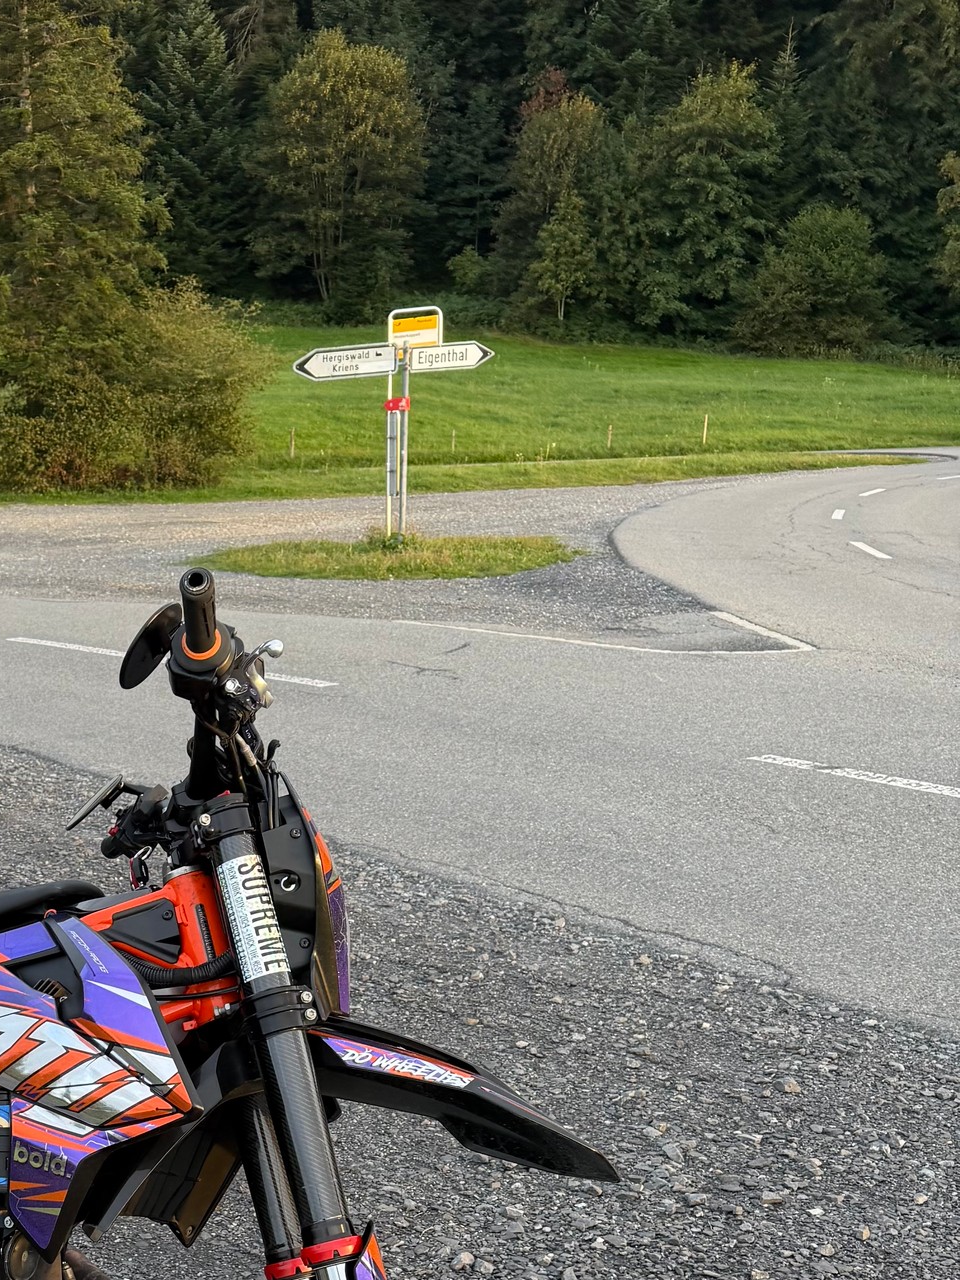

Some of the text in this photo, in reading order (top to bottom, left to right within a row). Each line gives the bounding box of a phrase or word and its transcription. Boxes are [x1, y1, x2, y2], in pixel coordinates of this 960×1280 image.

[322, 350, 370, 365] Hergiswald
[418, 348, 468, 367] Eigenthal
[332, 363, 360, 373] Kriens
[237, 860, 289, 972] SUPREME
[341, 1047, 474, 1089] DO WHEELIES
